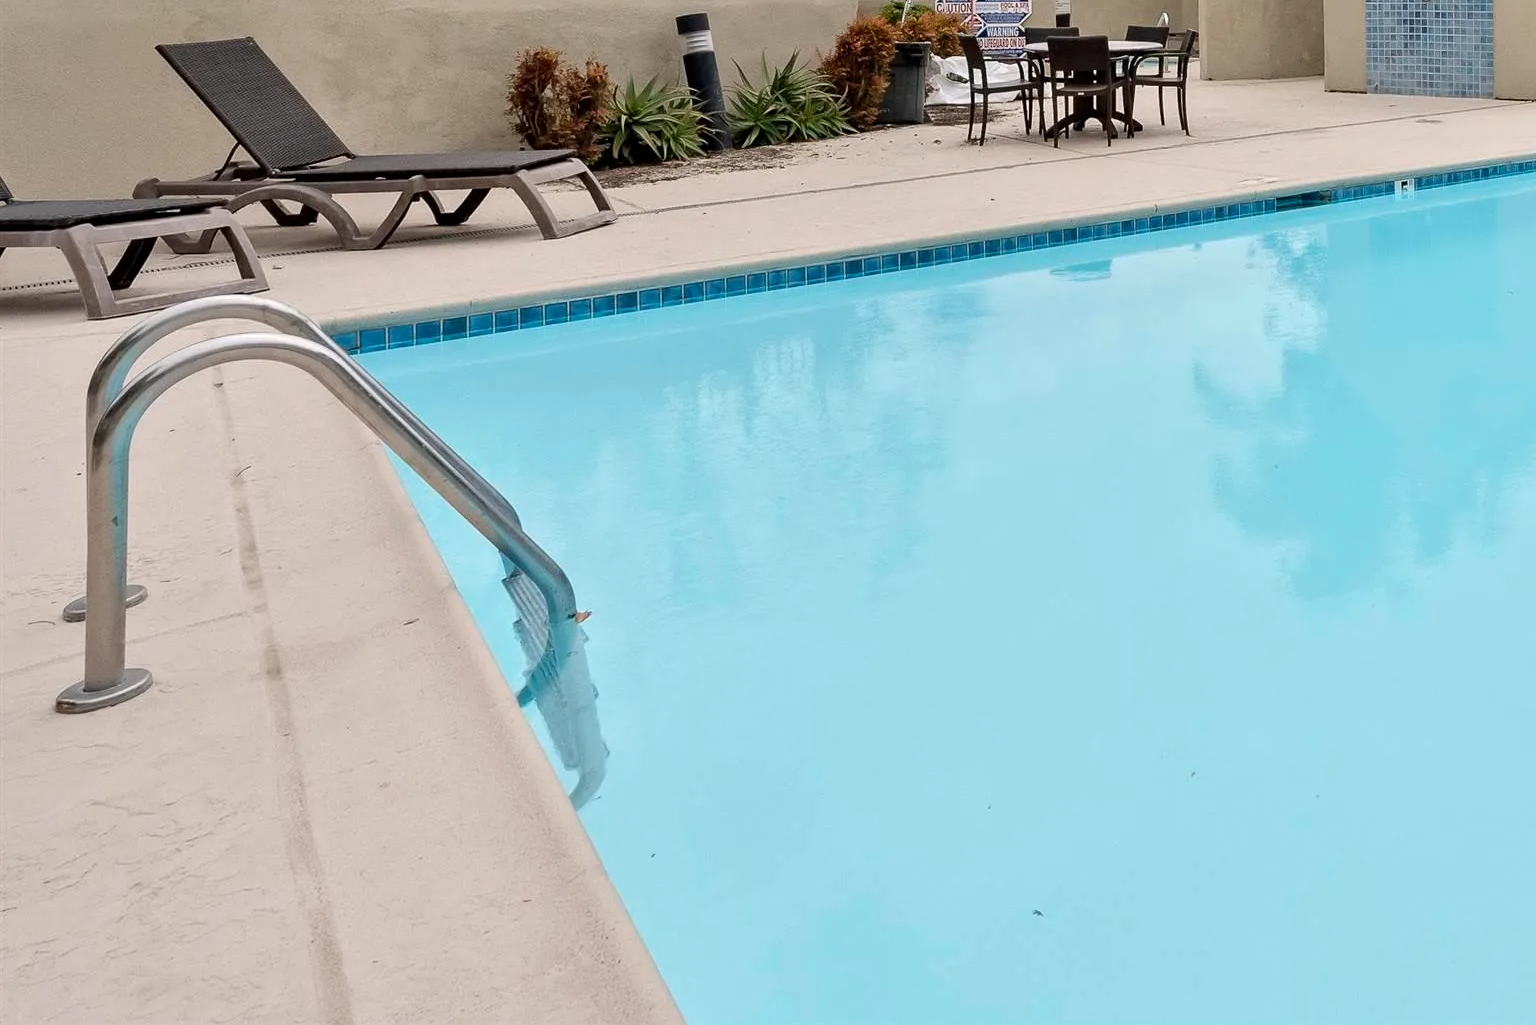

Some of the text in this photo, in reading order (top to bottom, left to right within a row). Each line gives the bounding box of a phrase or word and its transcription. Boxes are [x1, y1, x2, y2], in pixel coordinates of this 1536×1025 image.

[936, 3, 972, 13] CUTION
[986, 27, 1019, 37] WARNING
[984, 38, 1009, 48] LIFEGUARD
